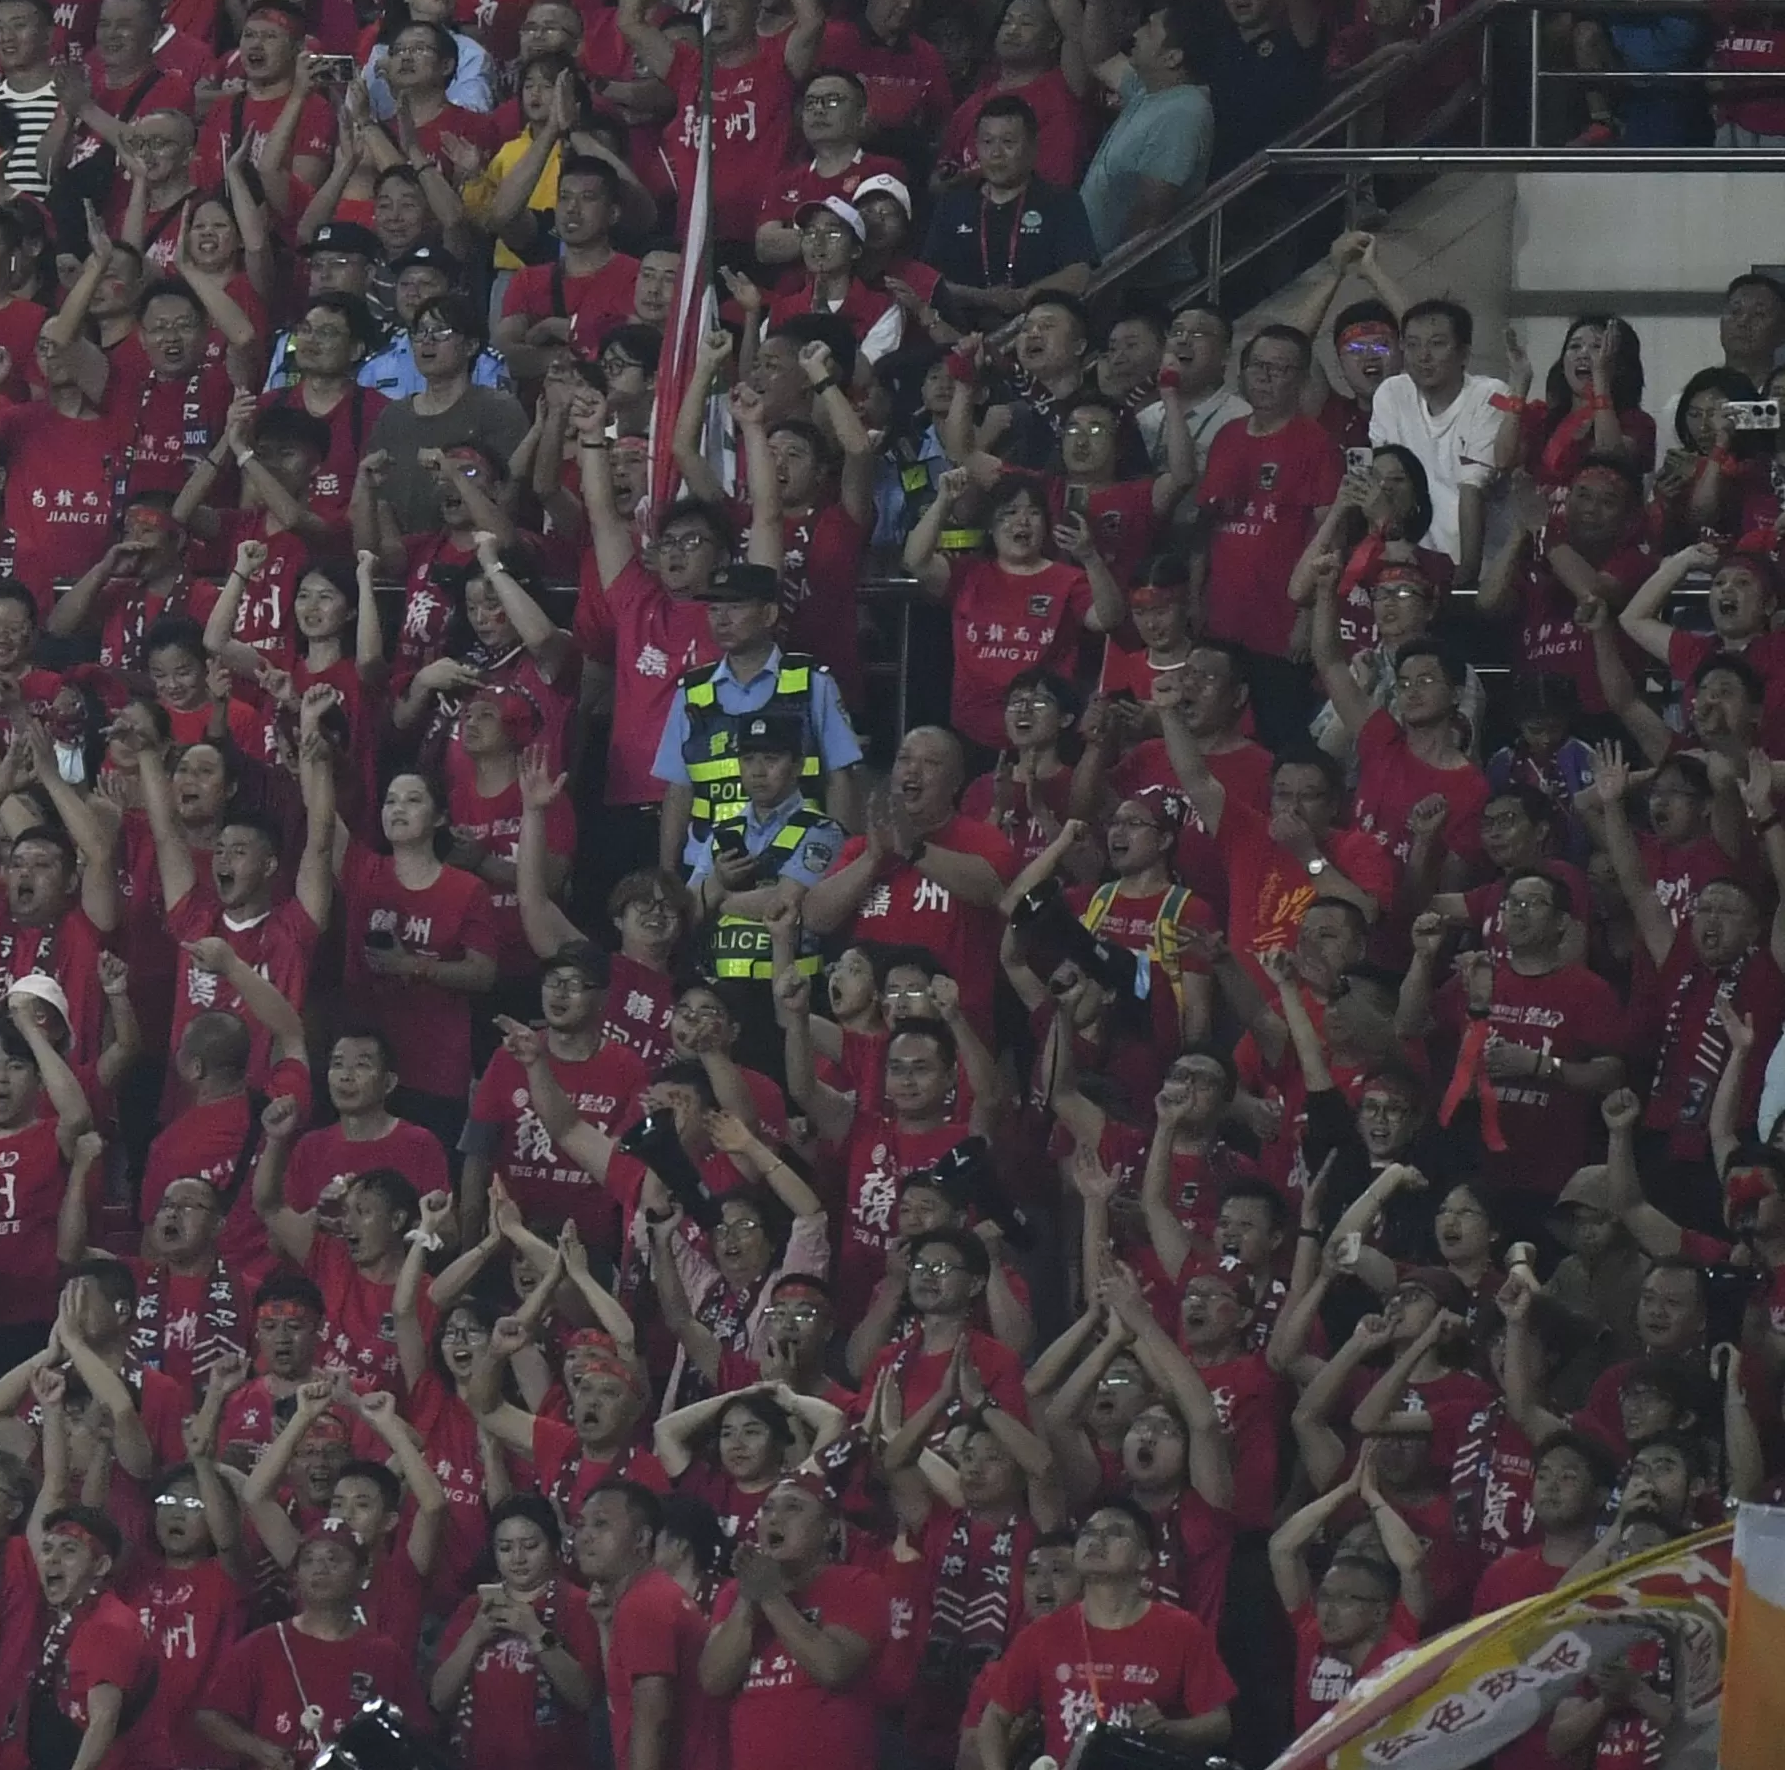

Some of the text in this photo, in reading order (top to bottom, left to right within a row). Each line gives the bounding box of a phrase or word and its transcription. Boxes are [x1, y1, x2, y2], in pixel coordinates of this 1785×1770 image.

[46, 512, 107, 525] JIANG XI
[978, 646, 1039, 661] JIANG XI
[189, 963, 269, 1008] 赣
